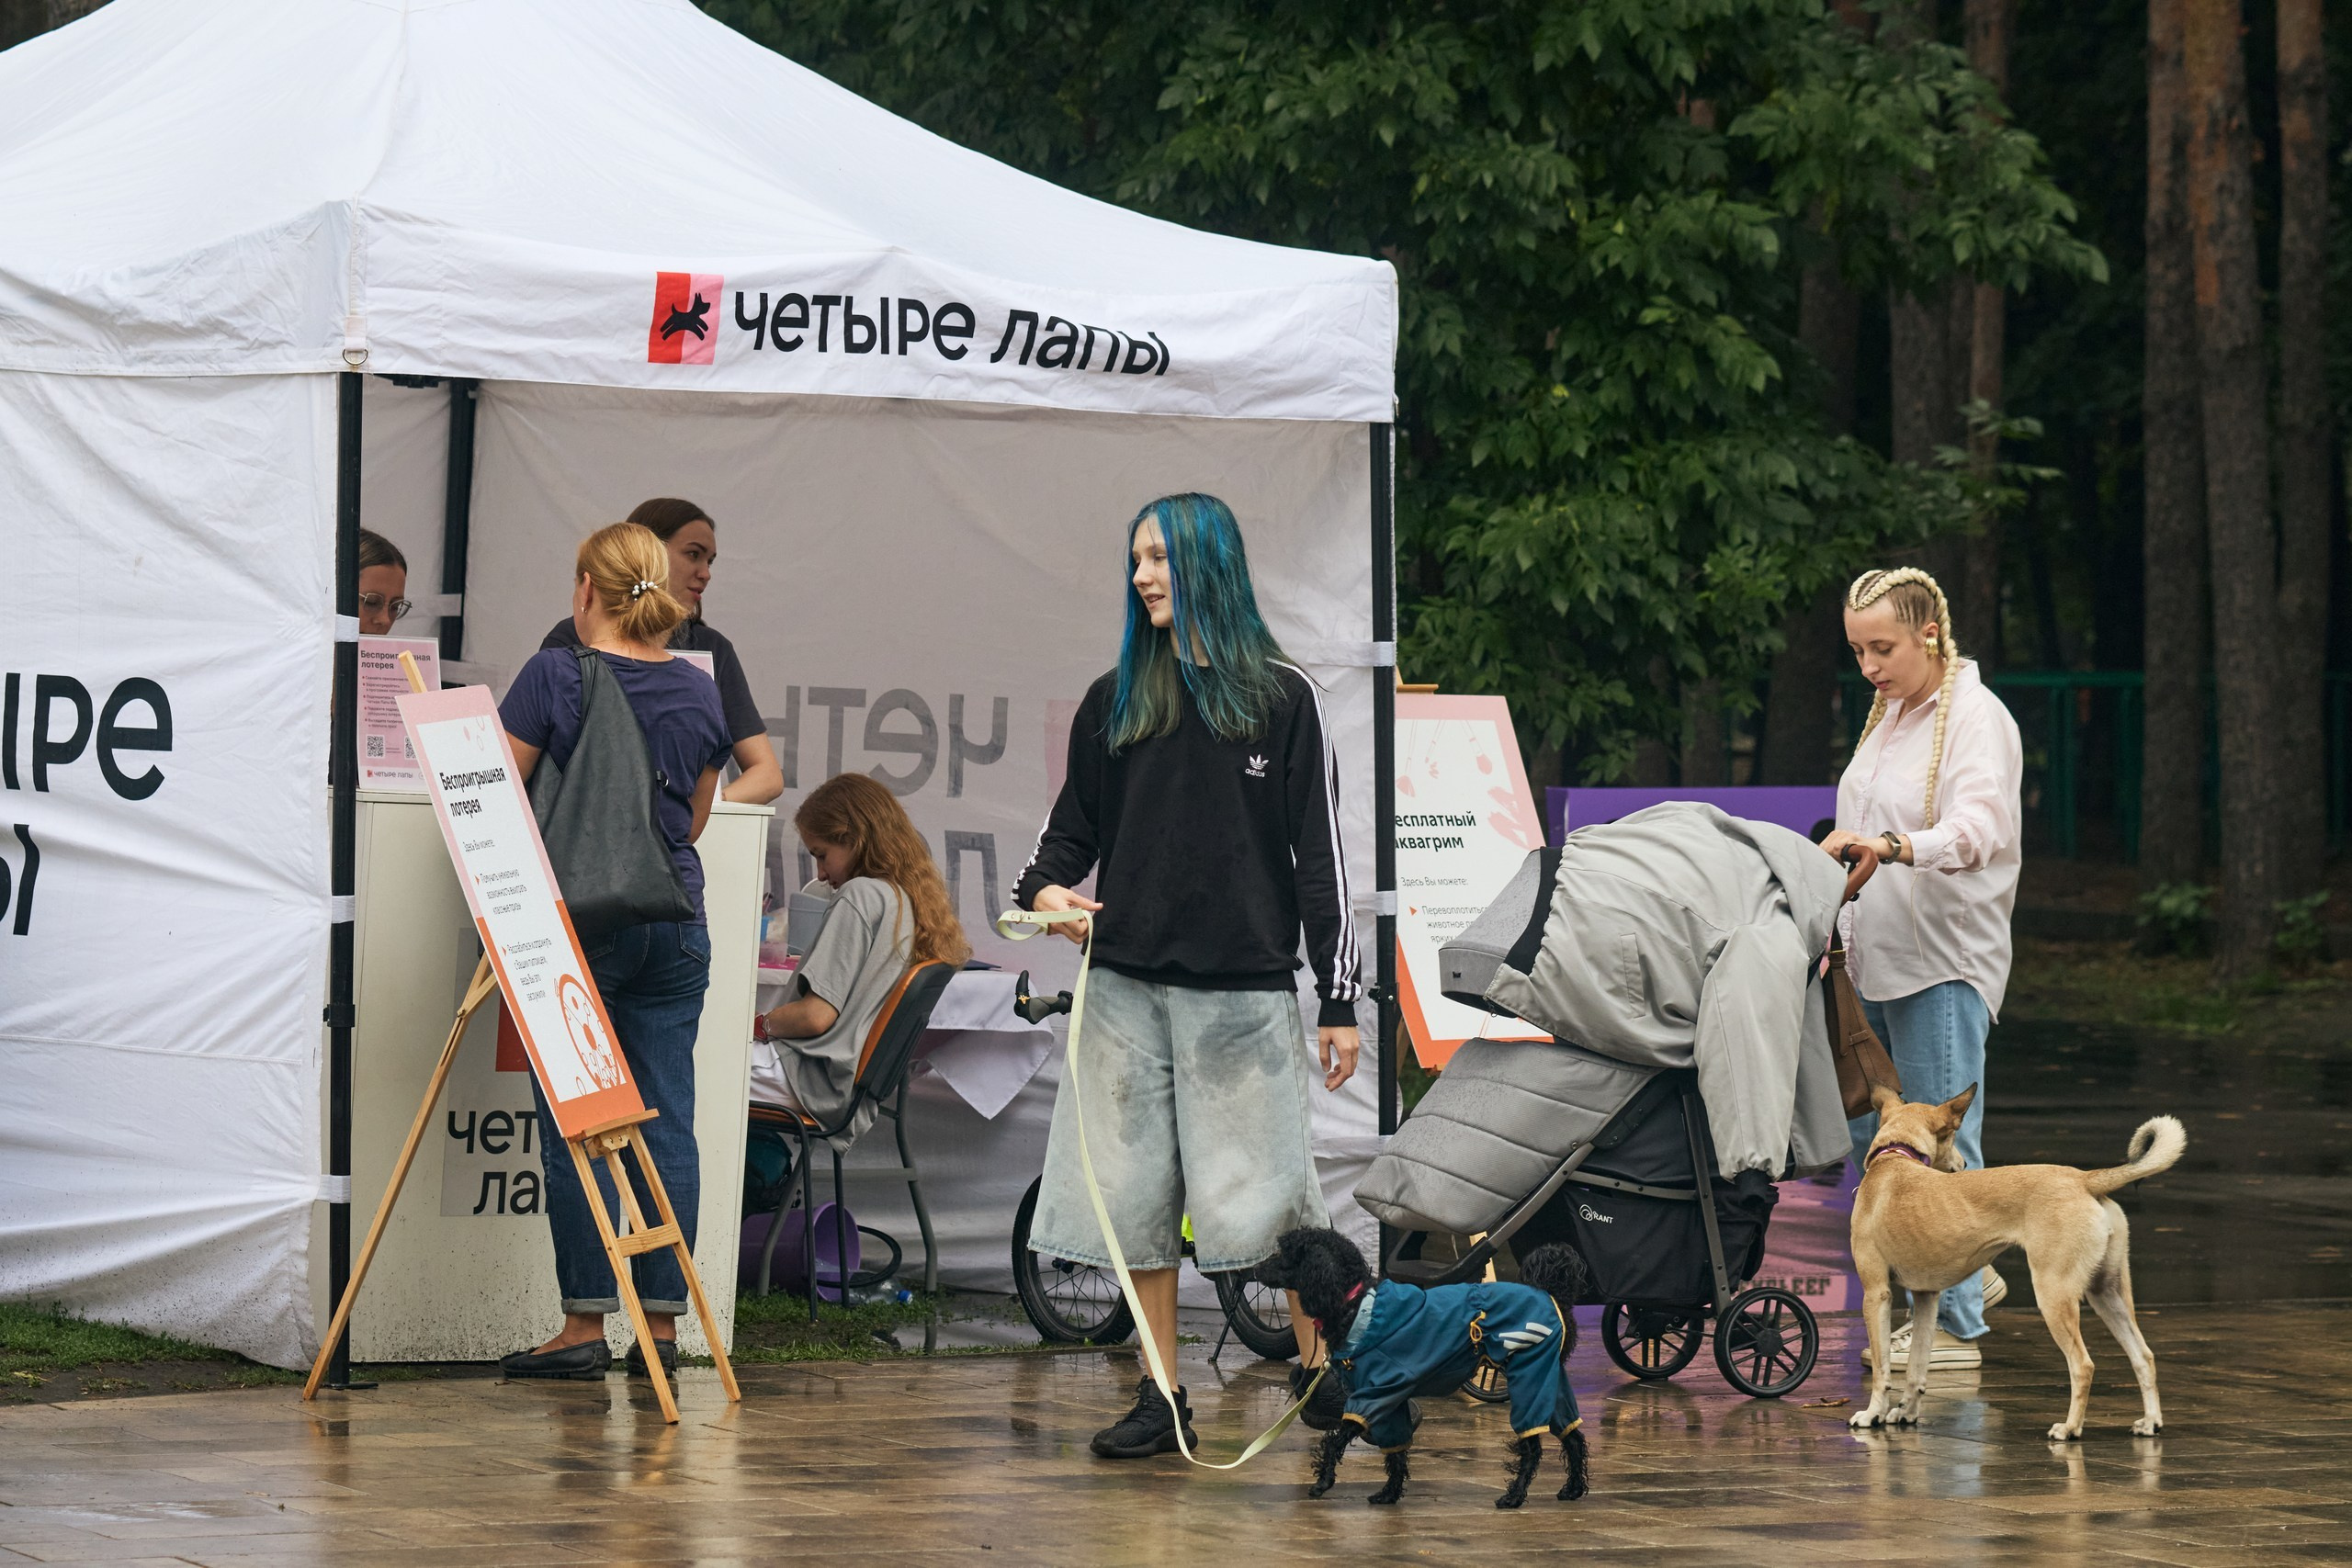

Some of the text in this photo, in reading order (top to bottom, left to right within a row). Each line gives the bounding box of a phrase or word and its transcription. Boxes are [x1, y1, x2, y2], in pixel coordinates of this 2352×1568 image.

[735, 291, 1170, 377] четыре лапы
[361, 650, 431, 661] Беспроигная
[361, 661, 394, 670] лотерея
[1245, 768, 1265, 778] adidas
[439, 768, 506, 793] Беспроигрышная
[450, 799, 482, 818] лотерея
[1396, 811, 1476, 827] есплатный
[1401, 876, 1424, 887] Здесь
[1424, 876, 1436, 886] Вы
[1421, 906, 1488, 916] Перевоплотитьс
[1426, 920, 1464, 929] животное
[447, 1111, 538, 1154] чет
[473, 1170, 548, 1215] ла
